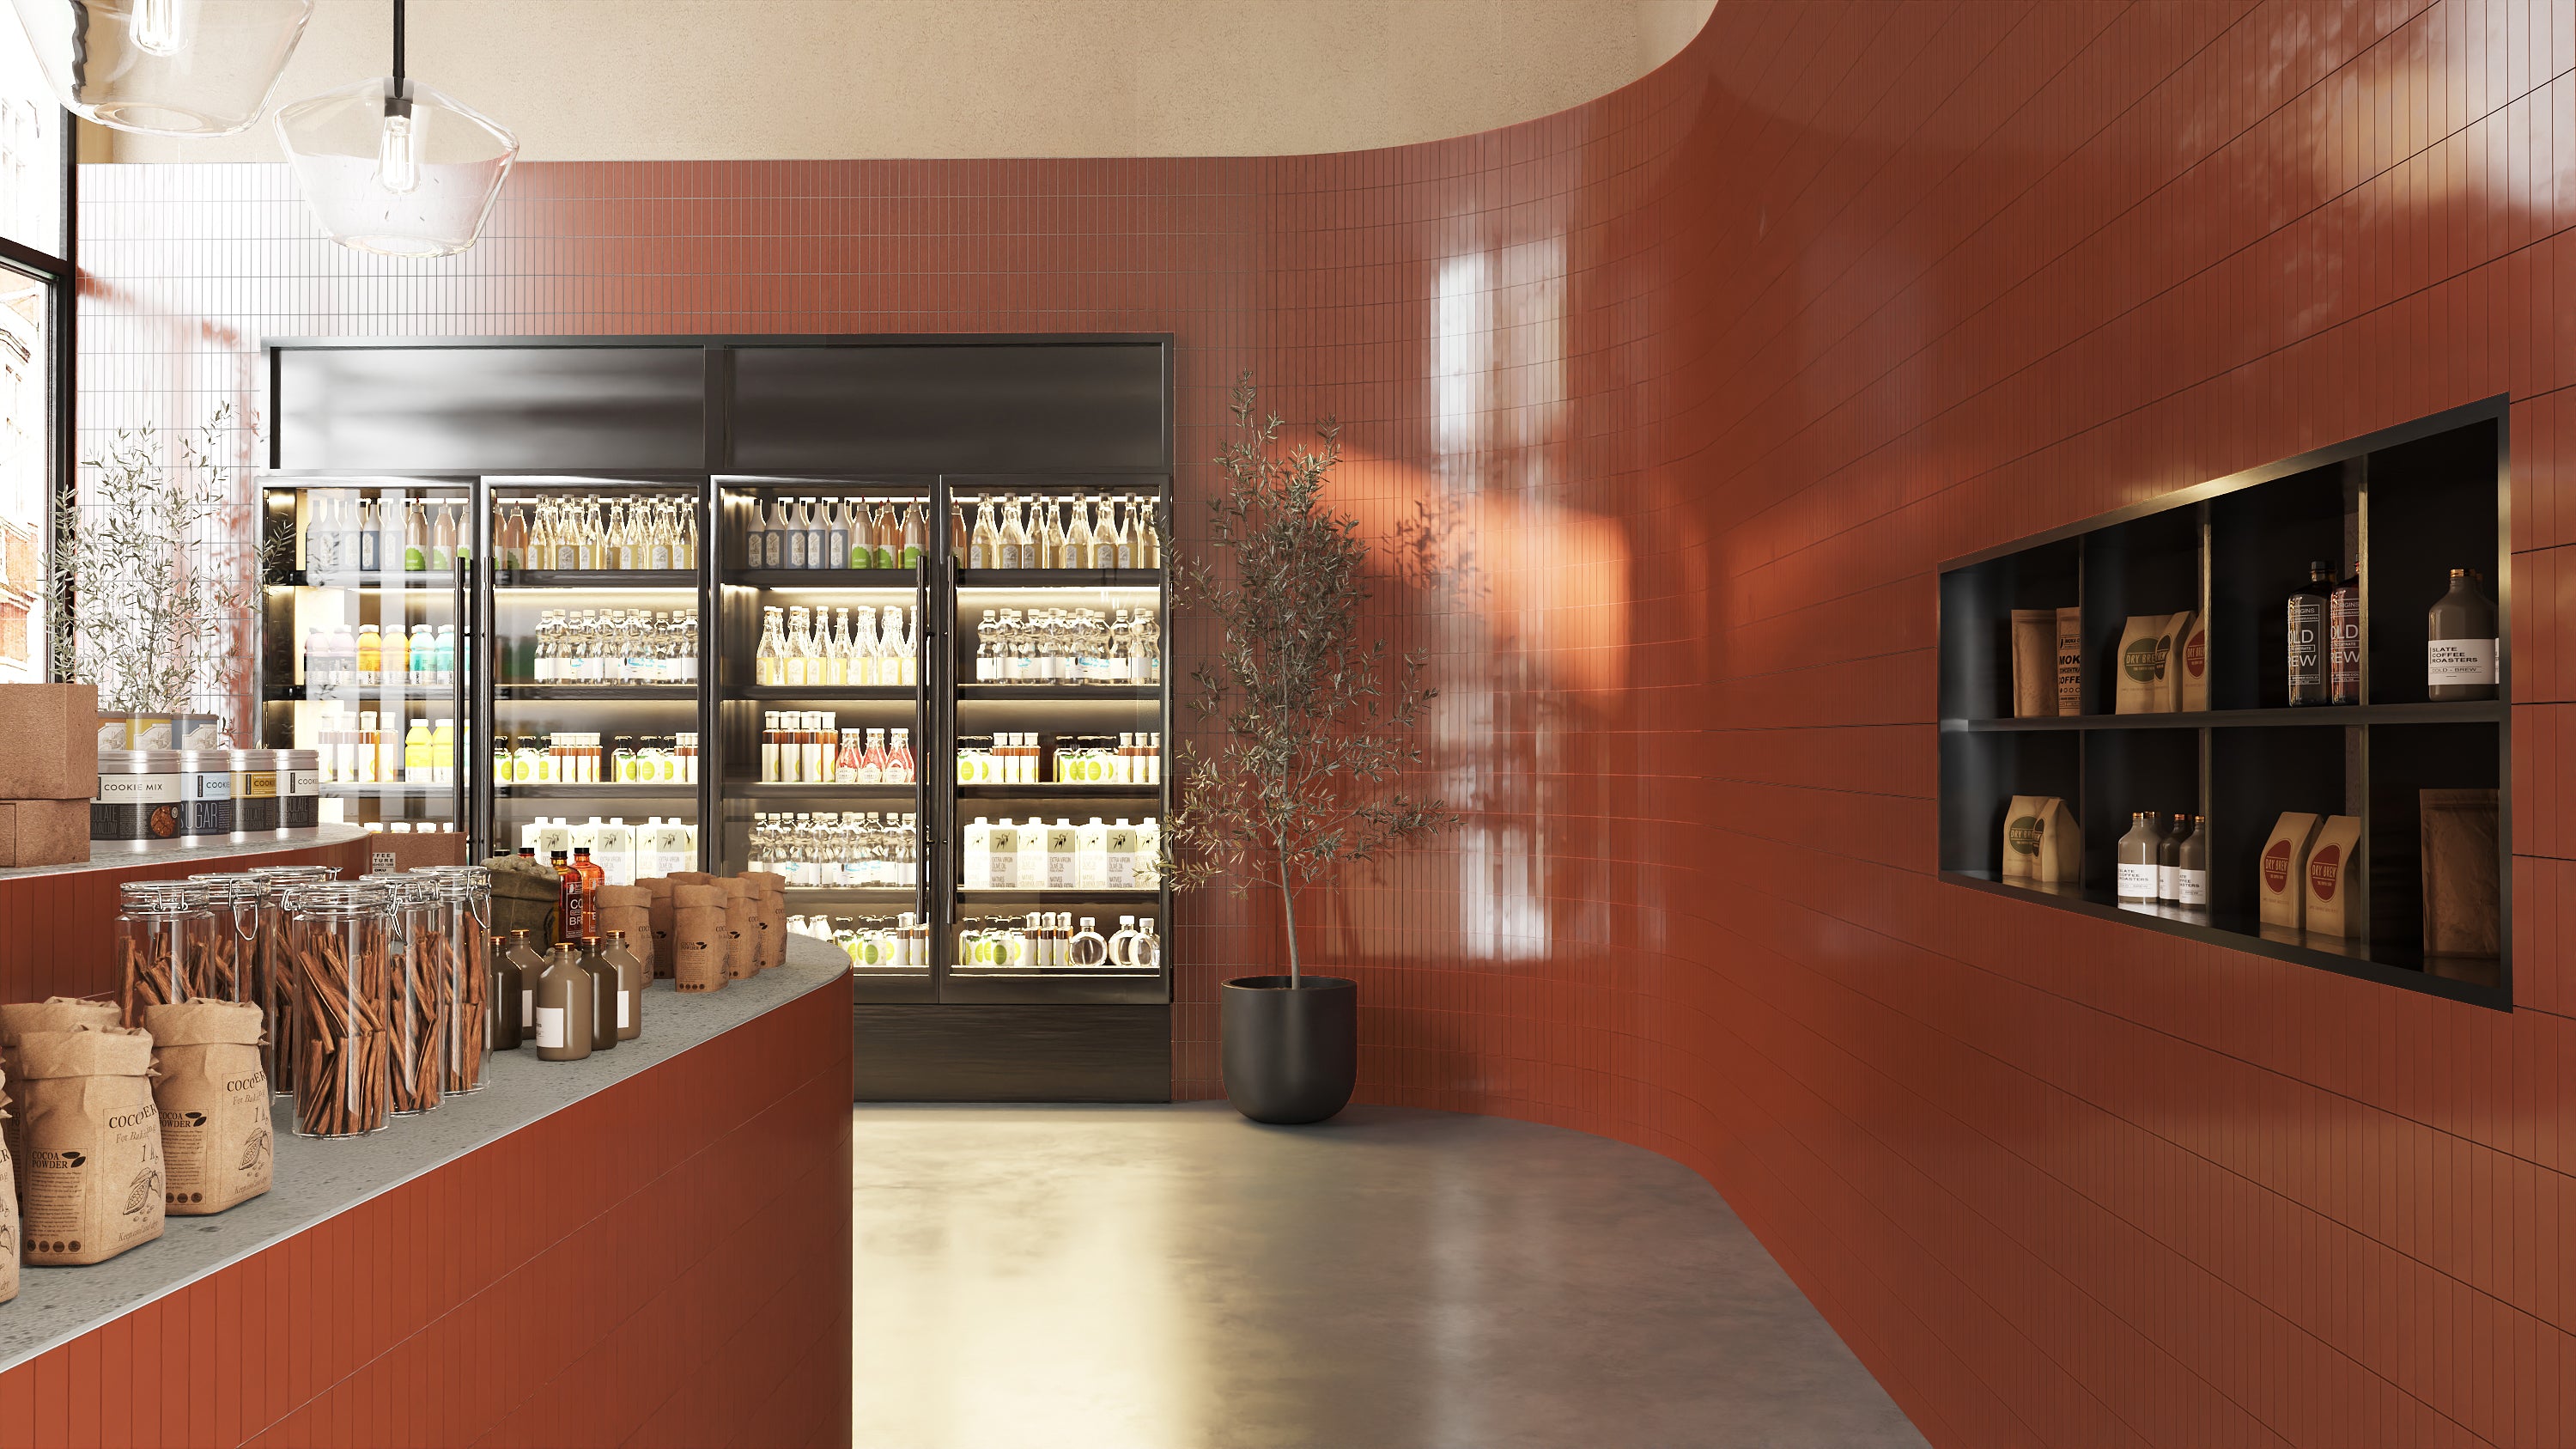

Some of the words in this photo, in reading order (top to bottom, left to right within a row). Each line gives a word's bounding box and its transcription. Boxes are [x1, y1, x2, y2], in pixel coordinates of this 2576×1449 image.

[2126, 654, 2140, 664] DRY
[2059, 676, 2081, 685] OFFE
[2312, 864, 2323, 876] DRY
[116, 1134, 129, 1143] For
[32, 1151, 59, 1160] COCOA
[32, 1160, 68, 1168] POWDER
